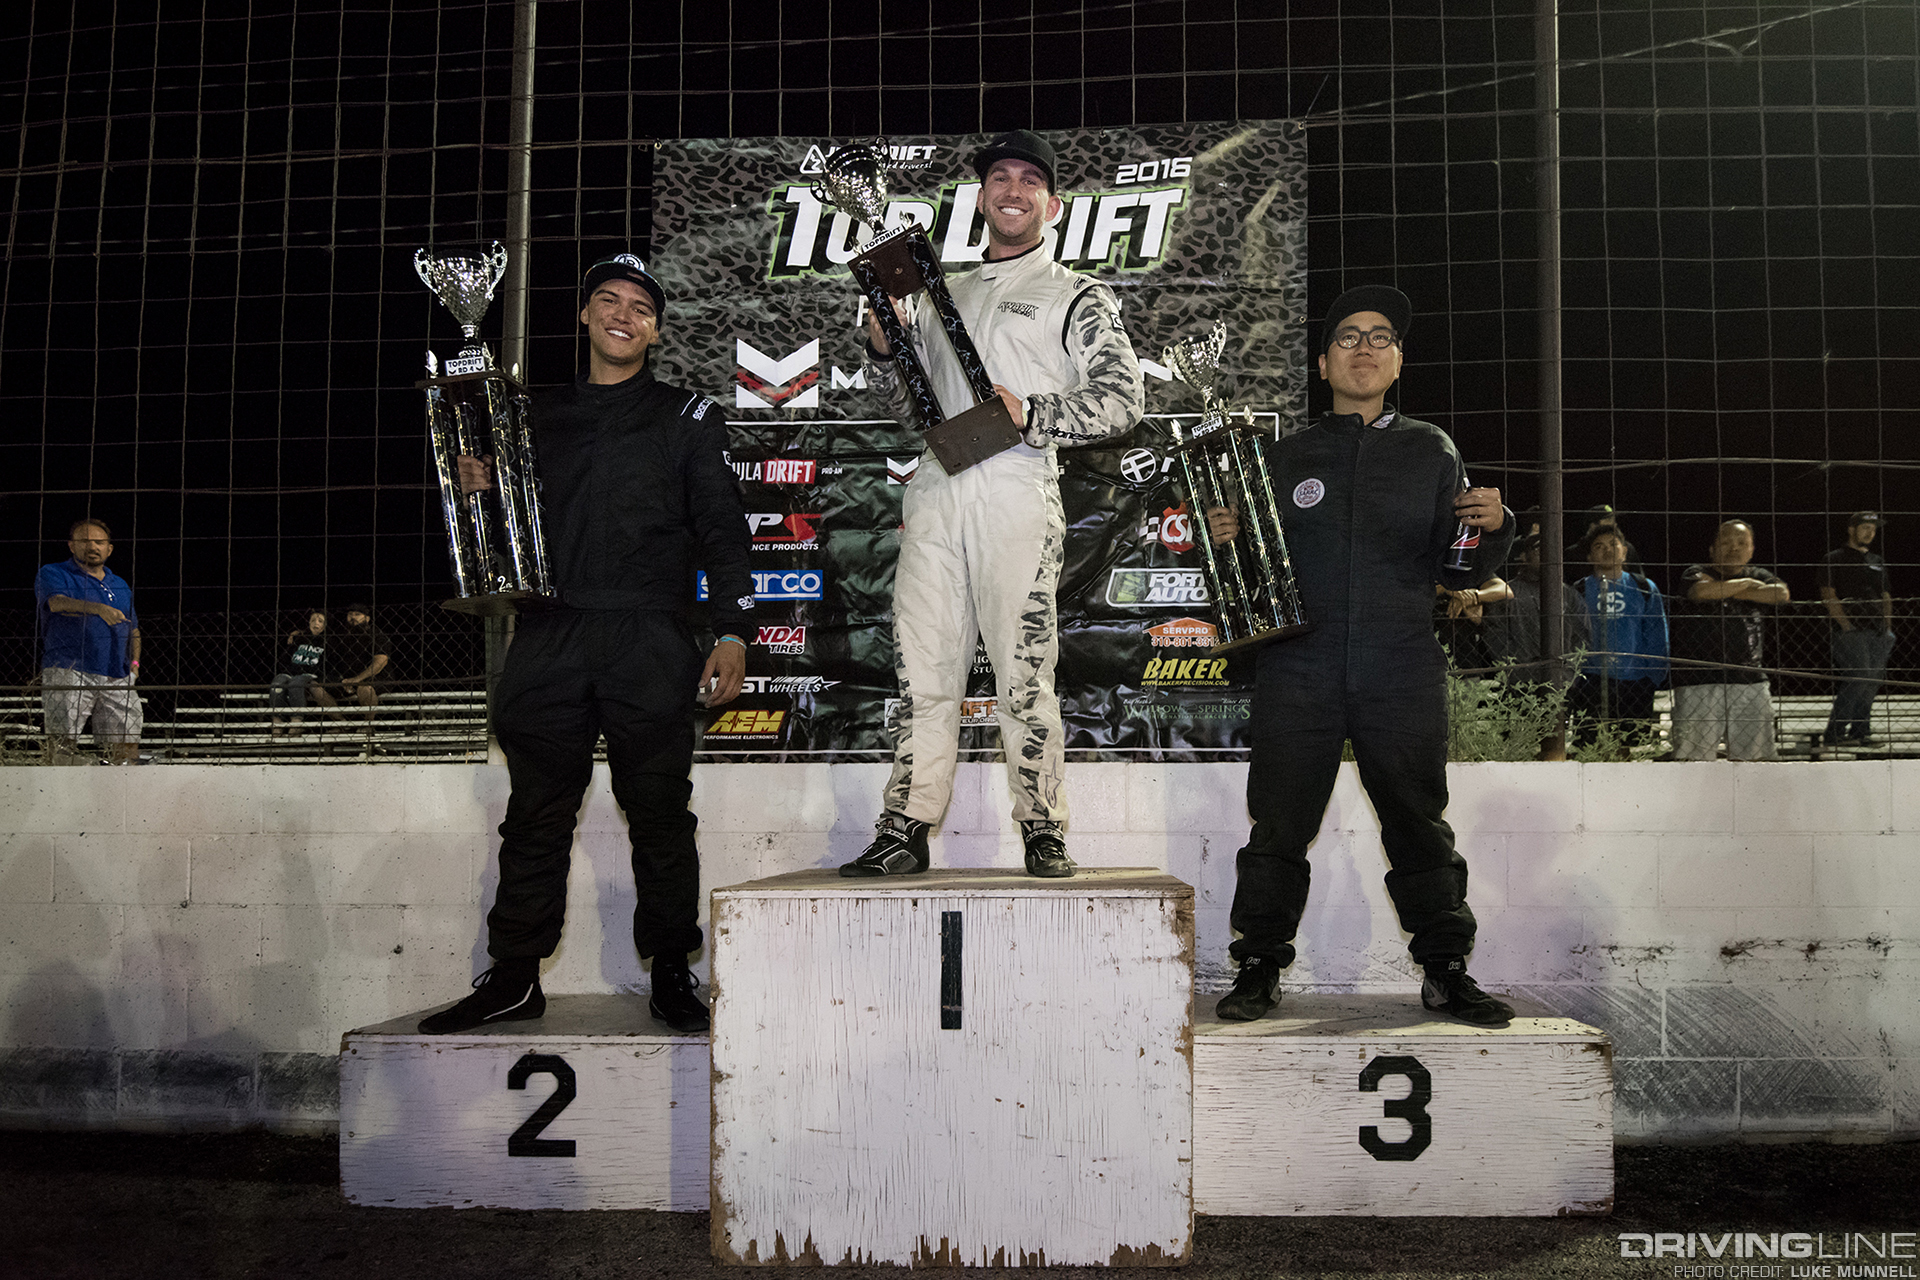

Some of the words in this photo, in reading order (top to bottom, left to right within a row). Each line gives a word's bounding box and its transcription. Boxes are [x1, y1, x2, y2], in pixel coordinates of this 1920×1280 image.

[1115, 156, 1193, 185] 2016
[863, 226, 903, 250] TOPDRIFT
[448, 358, 482, 367] TOPDRIFT
[765, 460, 814, 483] DRIFT
[772, 543, 819, 551] PRODUCTS
[1145, 586, 1209, 602] AUTO
[1162, 626, 1209, 635] SERVPRO
[769, 644, 805, 654] TIRES
[1142, 658, 1228, 680] BAKER
[769, 683, 822, 693] WHEELS
[1198, 703, 1251, 720] SPRINGS
[706, 710, 785, 733] AEM
[507, 1054, 577, 1158] 2
[1358, 1055, 1432, 1162] 3
